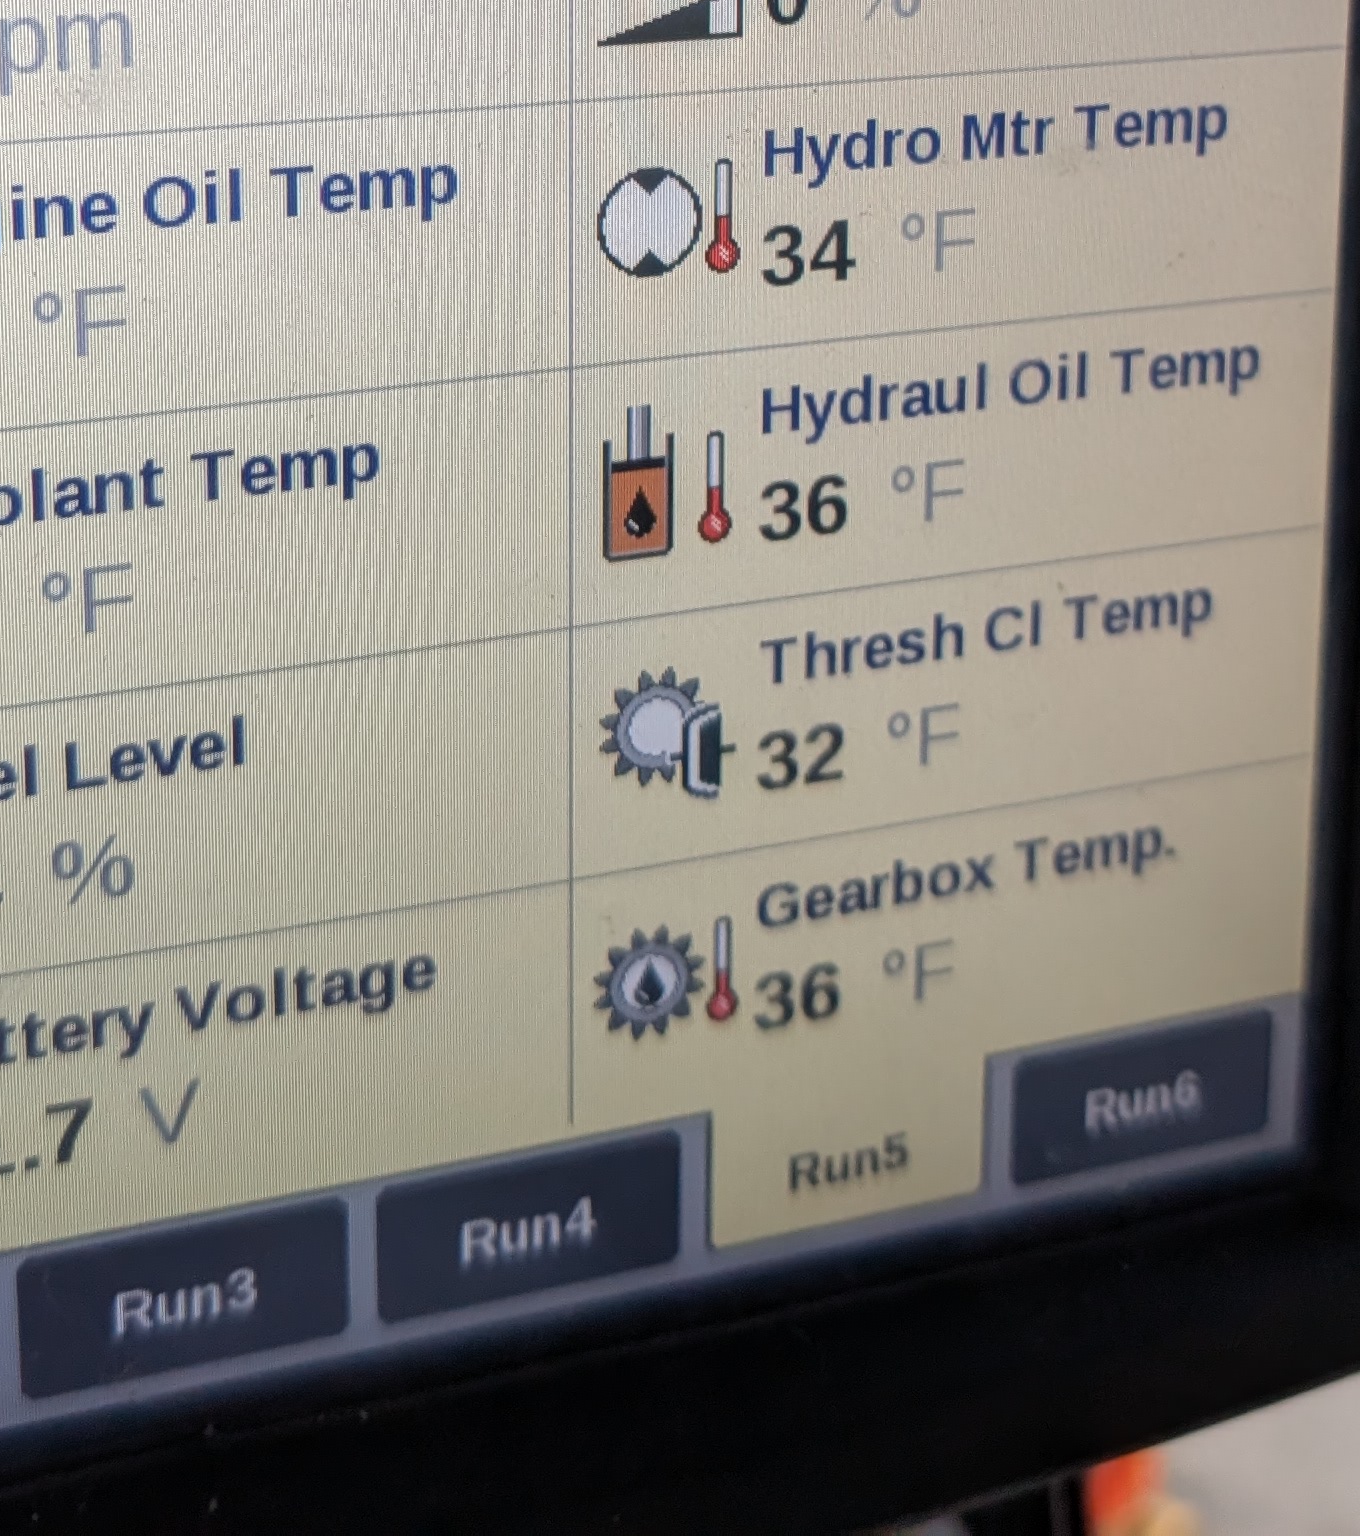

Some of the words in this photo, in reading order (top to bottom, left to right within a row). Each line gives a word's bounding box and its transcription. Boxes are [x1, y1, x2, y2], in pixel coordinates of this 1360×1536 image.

[764, 117, 941, 188] Hydro
[962, 109, 1054, 161] Mtr
[1074, 96, 1228, 157] Temp
[143, 168, 241, 229] Oil
[270, 159, 458, 221] Temp
[761, 220, 855, 286] 34
[762, 363, 987, 444] Hydraul
[1009, 351, 1086, 405] Oil
[1110, 338, 1260, 396] Temp
[191, 440, 380, 503] Temp
[759, 474, 848, 542] 36
[760, 613, 964, 685] Thresh
[1063, 585, 1212, 641] Temp
[65, 715, 245, 791] Level
[757, 724, 845, 792] 32
[52, 833, 135, 908] %
[757, 846, 994, 930] Gearbox
[1015, 824, 1176, 883] Temp.
[175, 950, 437, 1031] Voltage
[755, 962, 840, 1032] 36
[140, 1078, 200, 1144] V
[1085, 1070, 1199, 1133] Run6
[788, 1135, 909, 1194] Run5
[461, 1197, 596, 1266] Run4
[113, 1269, 257, 1337] Run3
